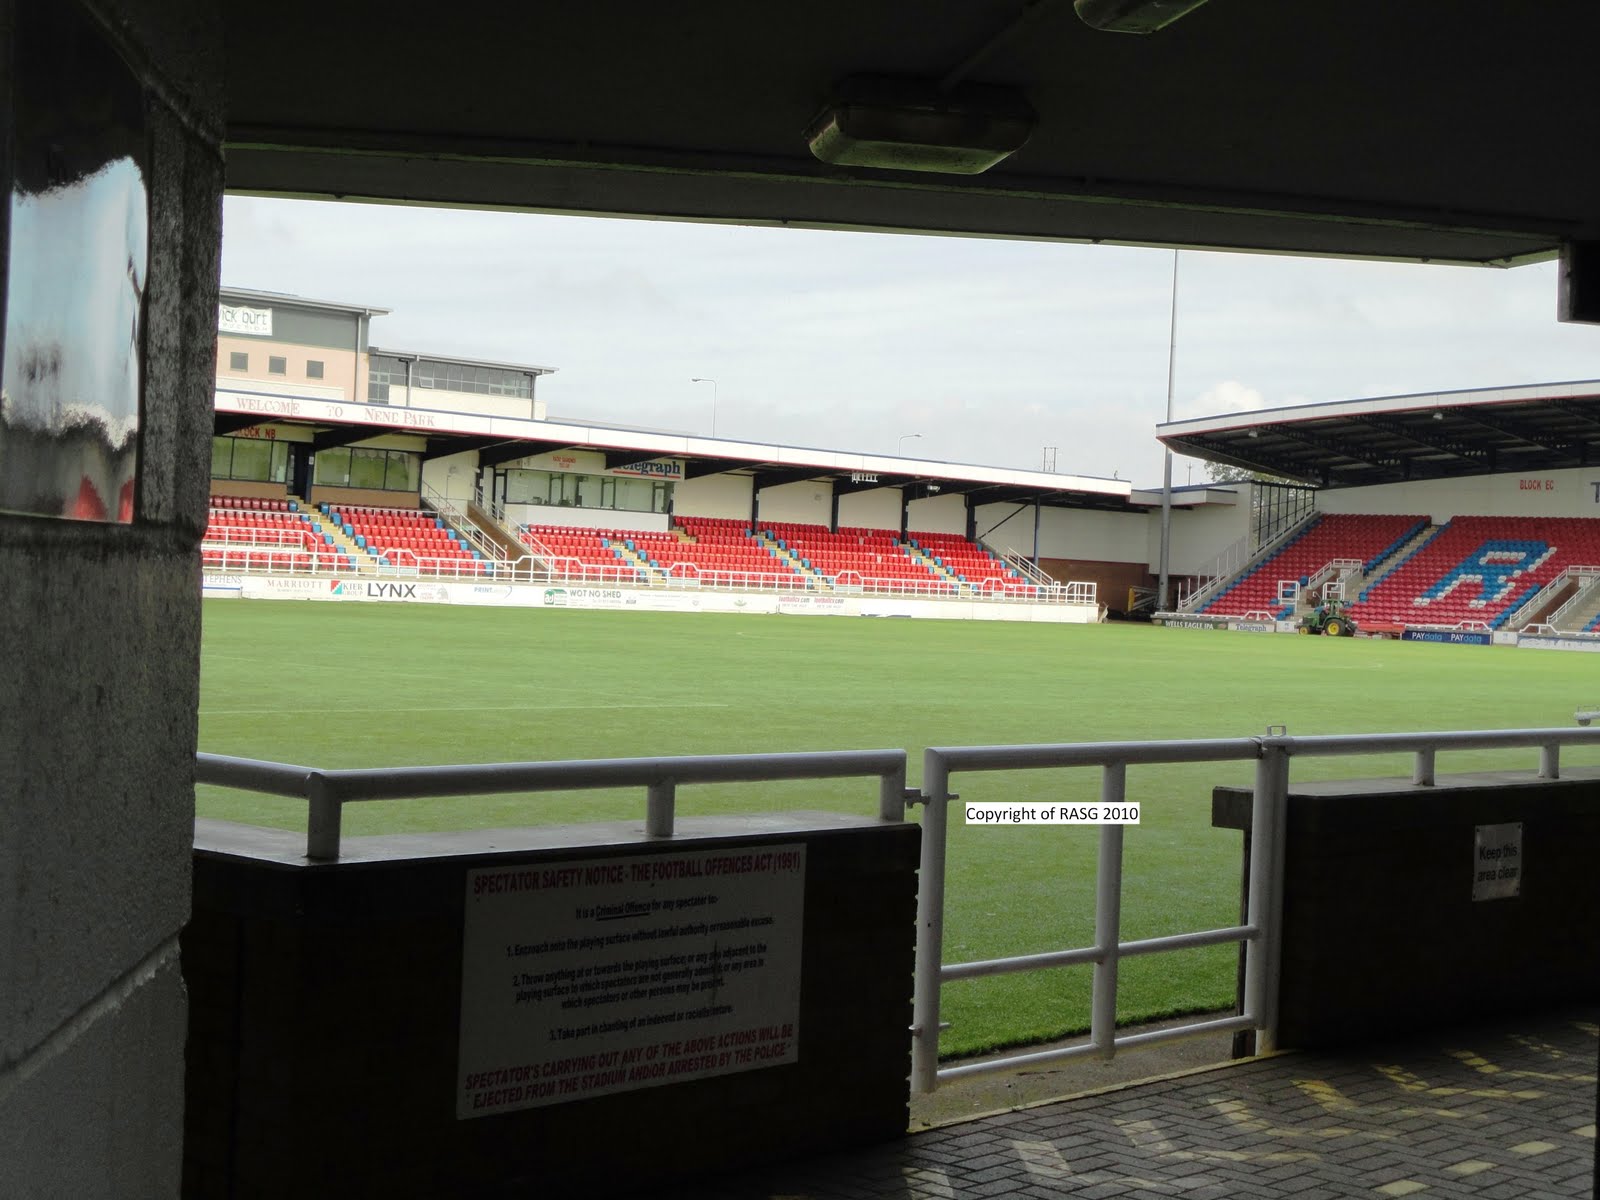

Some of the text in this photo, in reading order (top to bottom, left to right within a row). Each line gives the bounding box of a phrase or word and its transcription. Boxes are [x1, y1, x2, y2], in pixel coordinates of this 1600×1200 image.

[242, 310, 267, 325] burt
[236, 397, 300, 415] WELCOME
[326, 405, 343, 418] TO
[403, 411, 434, 427] PARK
[615, 461, 681, 477] elegraph
[1520, 480, 1554, 490] BLOCK EC
[267, 580, 322, 588] MARRIOTT
[343, 582, 362, 590] KIER
[367, 582, 416, 598] LYNX
[569, 589, 622, 599] WOT NO SHED
[1165, 620, 1183, 628] WELLS
[1184, 621, 1203, 630] EAGLE
[1412, 632, 1482, 644] PAYdata PAYdata
[1480, 844, 1518, 862] Keep this
[473, 872, 539, 894] SPECTATOR
[542, 868, 583, 889] SAFETY
[585, 865, 624, 885] NOTICE
[631, 863, 650, 881] THE
[652, 860, 702, 880] FOOTBALL
[706, 856, 752, 876] OFFENCES
[754, 853, 771, 871] ACT
[773, 851, 800, 874] (1991)
[1478, 870, 1497, 881] area
[596, 904, 624, 917] Criminal
[625, 901, 651, 914] Offence
[652, 900, 661, 911] for
[662, 900, 674, 911] any
[675, 897, 707, 911] spectator
[514, 942, 548, 957] Encroach
[550, 941, 566, 952] onto
[567, 938, 578, 950] the
[579, 937, 604, 950] playing
[605, 932, 631, 945] surface
[632, 928, 657, 941] without
[658, 925, 679, 938] lawful
[680, 923, 708, 937] authority
[513, 975, 520, 987] 2.
[521, 973, 544, 985] Throw
[545, 968, 576, 984] anything
[576, 967, 584, 978] at
[584, 968, 592, 977] or
[593, 962, 621, 976] towards
[622, 960, 633, 971] the
[635, 958, 659, 971] playing
[687, 953, 695, 962] or
[696, 953, 708, 964] any
[722, 945, 749, 959] adjacent
[749, 945, 756, 955] to
[757, 943, 767, 954] the
[515, 990, 542, 1004] playing
[542, 985, 570, 998] surface
[579, 979, 600, 992] which
[600, 975, 637, 990] spectators
[638, 974, 649, 983] are
[650, 972, 661, 982] not
[662, 968, 693, 983] generally
[723, 963, 731, 972] or
[731, 960, 742, 972] any
[744, 959, 756, 968] area
[561, 997, 583, 1009] which
[584, 992, 620, 1008] spectators
[621, 991, 629, 1000] or
[629, 988, 648, 1000] other
[648, 986, 675, 1000] persons
[676, 983, 690, 995] may
[691, 981, 700, 991] be
[557, 1028, 575, 1040] Take
[576, 1026, 590, 1039] part
[591, 1024, 598, 1034] in
[599, 1018, 628, 1033] chanting
[629, 1017, 637, 1028] of
[637, 1017, 646, 1028] an
[646, 1011, 676, 1026] indecent
[677, 1011, 684, 1021] or
[465, 1023, 793, 1090] SPECTATOR'S CARRYING OUT ANY OF THE ABOVE ACTIONS WILL BE
[473, 1087, 523, 1109] EJECTED
[525, 1081, 556, 1100] FROM
[558, 1077, 578, 1095] THE
[581, 1068, 625, 1090] STADIUM
[667, 1053, 717, 1075] ARRESTED
[719, 1051, 732, 1066] BY
[734, 1048, 752, 1064] THE
[754, 1042, 786, 1061] POLICE
